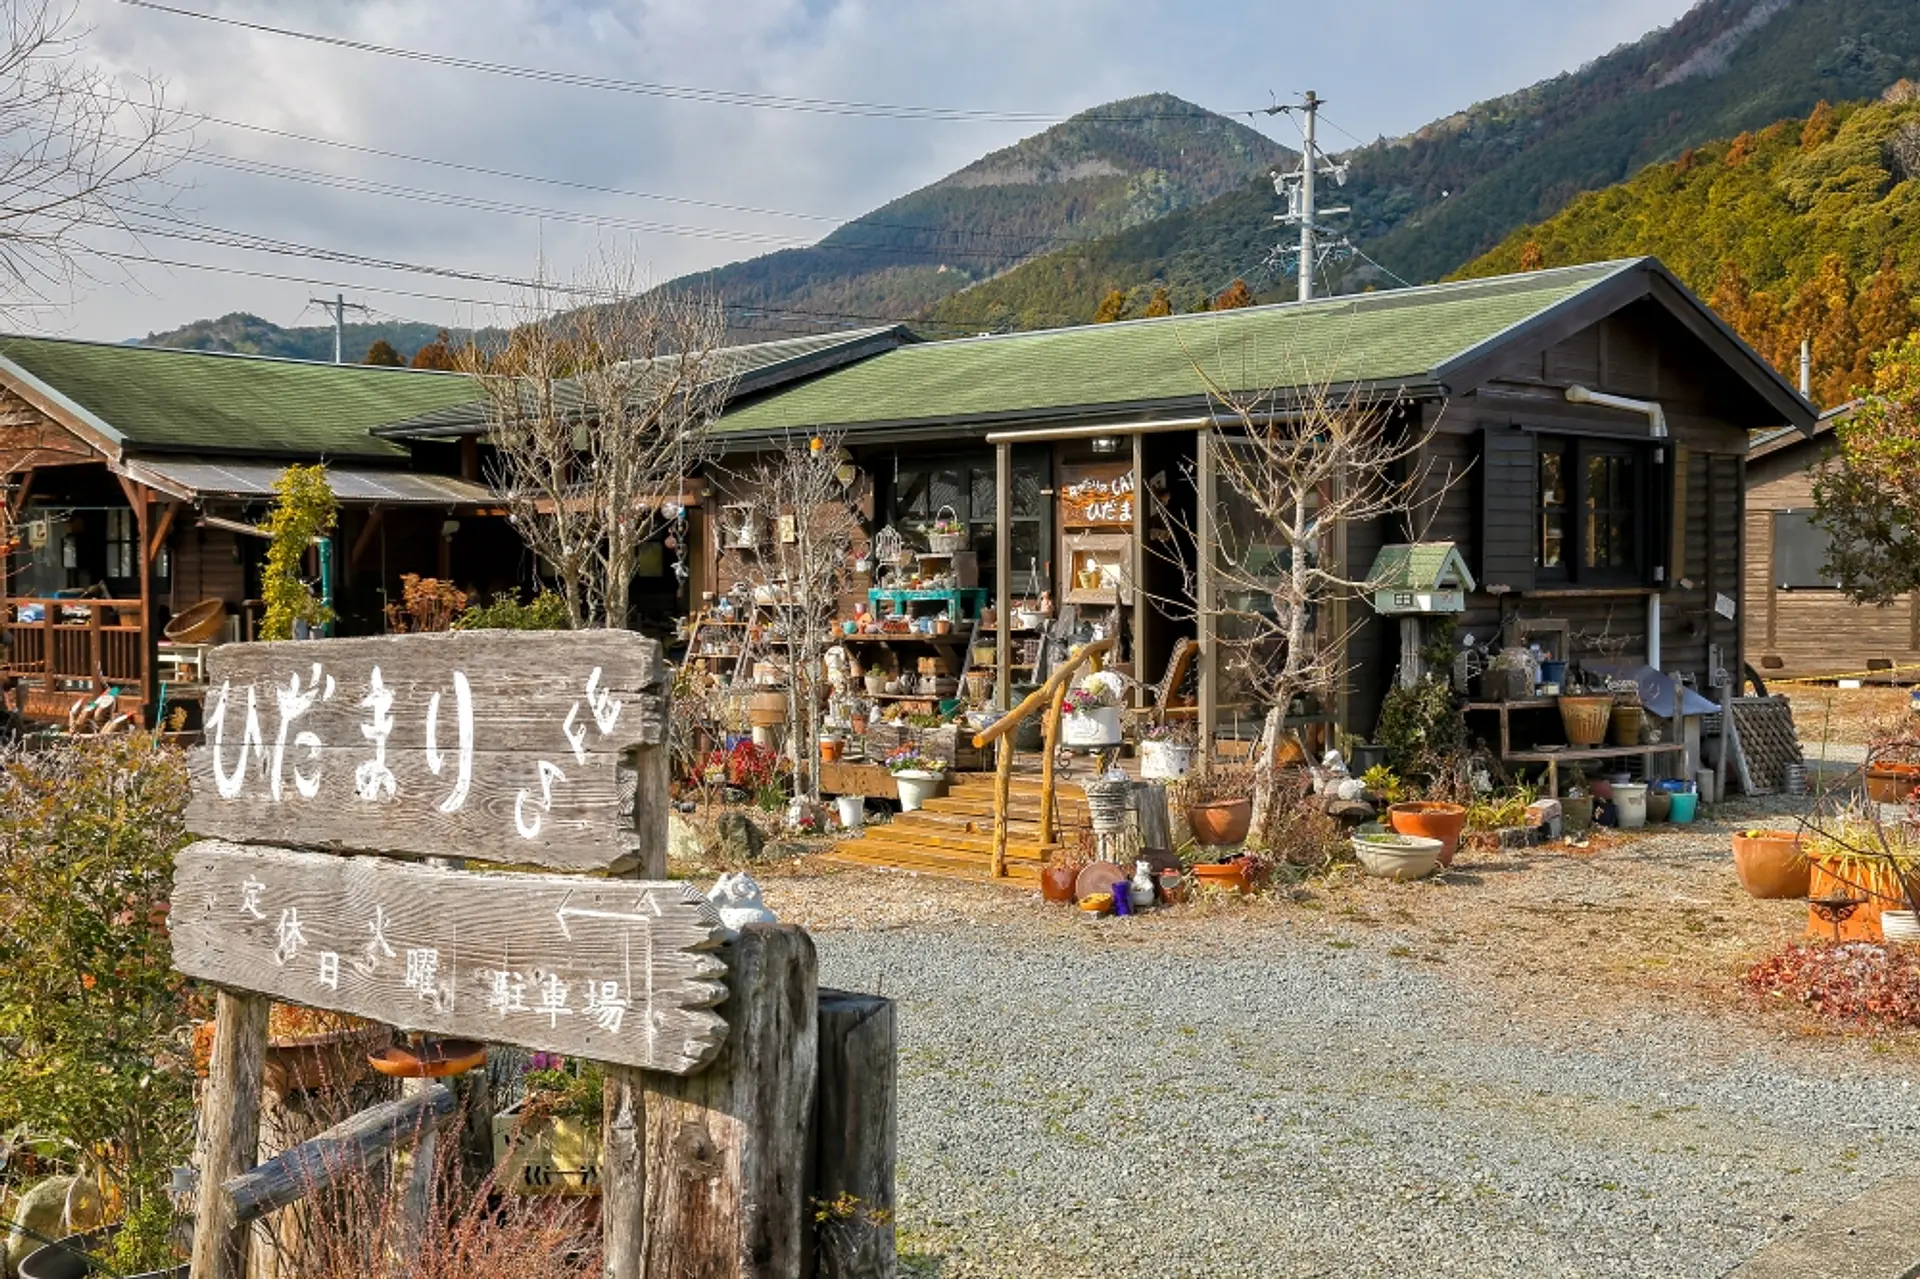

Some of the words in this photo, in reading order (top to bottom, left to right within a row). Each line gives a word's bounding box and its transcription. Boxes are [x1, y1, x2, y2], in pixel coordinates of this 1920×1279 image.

[204, 662, 474, 813] ひだまり
[240, 873, 340, 990] 定休日
[486, 971, 628, 1034] 駐車場
